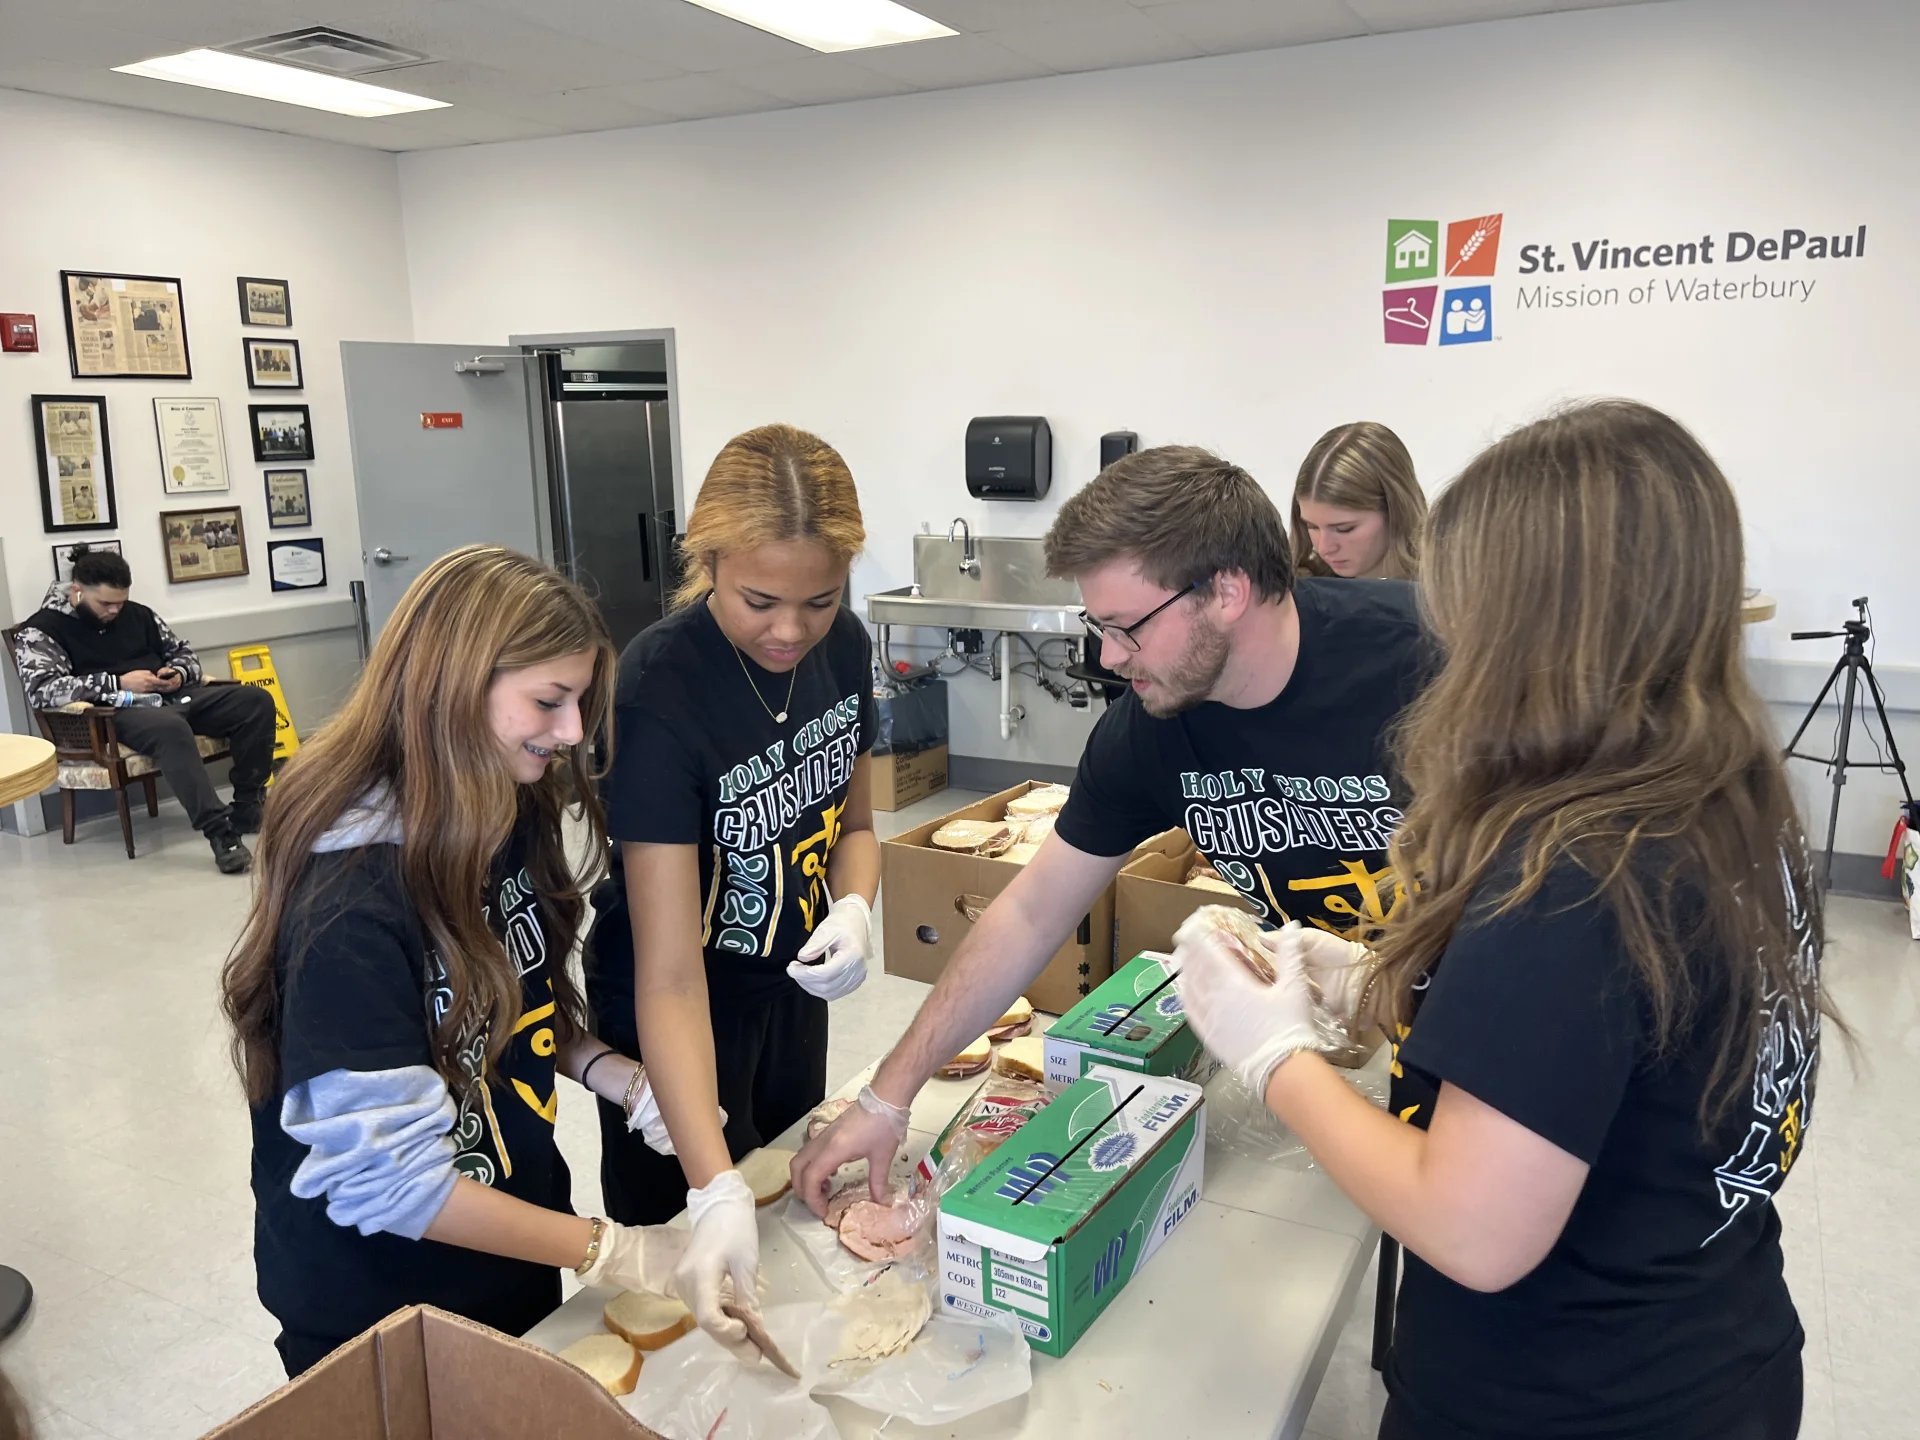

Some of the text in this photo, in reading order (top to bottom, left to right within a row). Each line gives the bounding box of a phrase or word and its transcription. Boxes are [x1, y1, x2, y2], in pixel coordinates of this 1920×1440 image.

[1517, 225, 1867, 274] St. Vincent DePaul
[1516, 274, 1816, 310] Mission of Waterbury
[719, 693, 859, 803] HOLY CROSS
[1180, 768, 1391, 802] HOLY CROSS
[1185, 797, 1410, 858] CRUSADERS
[1050, 1055, 1068, 1067] SIZE
[1143, 1094, 1188, 1131] FILM
[1163, 1188, 1197, 1237] FILM
[946, 1250, 982, 1270] METRIC
[947, 1271, 976, 1288] CODE
[993, 1266, 1015, 1283] 305mm
[1020, 1275, 1043, 1292] 609.6m
[995, 1287, 1006, 1299] 122
[955, 1299, 997, 1319] WESTERN
